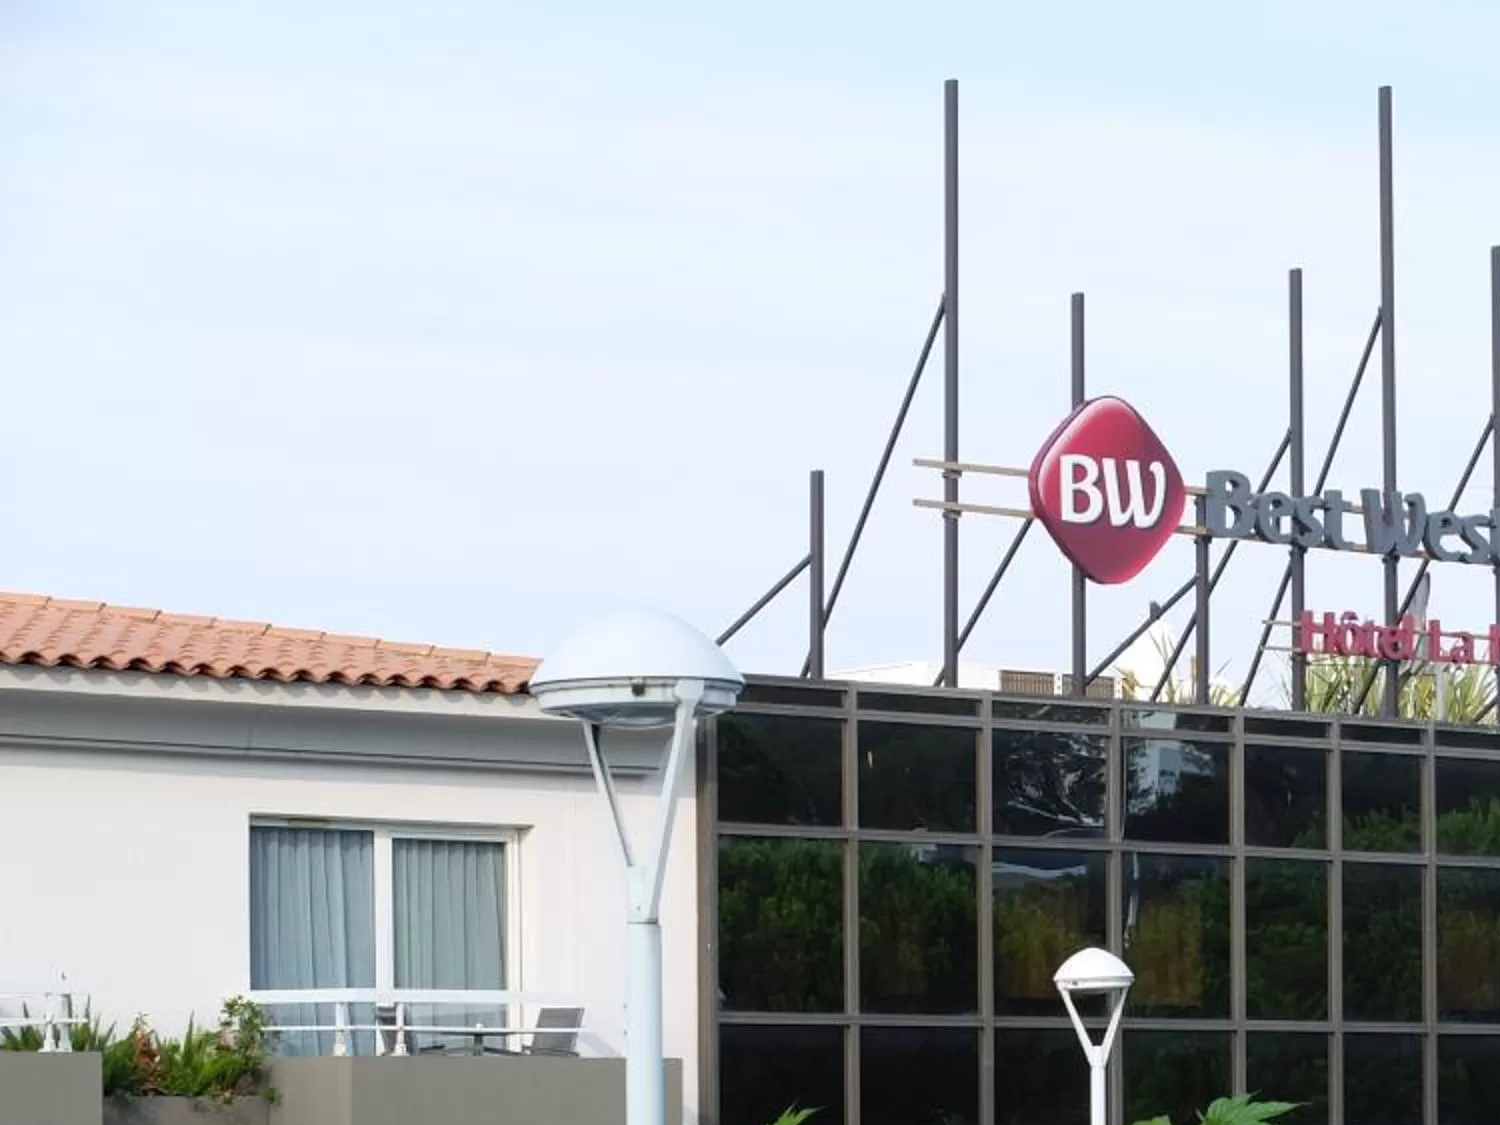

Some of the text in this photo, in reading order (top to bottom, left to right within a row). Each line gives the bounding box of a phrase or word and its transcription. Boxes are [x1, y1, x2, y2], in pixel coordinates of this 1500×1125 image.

[1058, 453, 1166, 530] BW
[1205, 469, 1354, 550] Best
[1300, 610, 1414, 661] Hôtel
[1428, 619, 1474, 664] La
